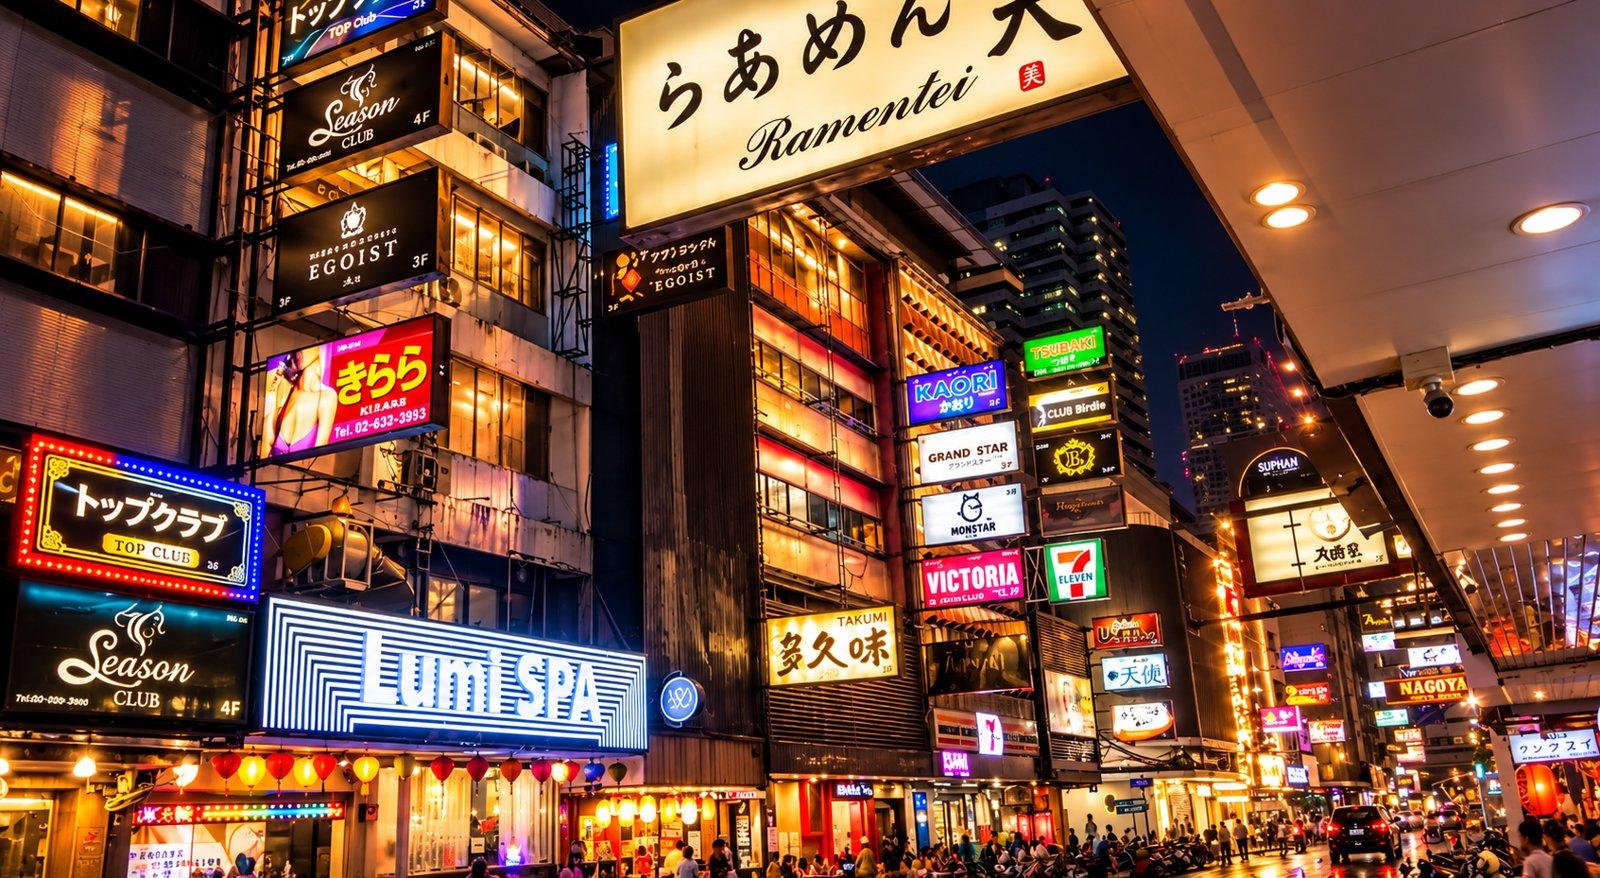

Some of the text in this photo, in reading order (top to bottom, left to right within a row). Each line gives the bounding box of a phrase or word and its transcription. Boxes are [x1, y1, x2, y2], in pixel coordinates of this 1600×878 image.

[328, 11, 377, 39] TOP Club
[1022, 64, 1043, 90] 美
[308, 96, 400, 147] Season
[413, 110, 431, 125] 4F
[739, 65, 978, 171] Ramentei
[341, 128, 374, 149] CLUB
[308, 239, 398, 281] EGOIST
[412, 253, 429, 268] 3F
[655, 267, 716, 292] EGOIST
[279, 296, 291, 308] 3F
[1030, 335, 1097, 360] TSUBAKI
[336, 345, 428, 406] きらら
[915, 370, 998, 403] KAORI
[940, 396, 974, 414] かおり
[1048, 401, 1106, 420] CLUB Birdie
[334, 407, 427, 438] Tel. 02-632-3993
[928, 442, 1008, 463] GRAND STAR
[1257, 457, 1299, 473] SUPHAN
[76, 483, 228, 543] トップクラブ
[951, 521, 996, 537] MONSTAR
[115, 539, 192, 565] TOP CLUB
[926, 562, 1019, 594] VICTORIA
[1058, 572, 1093, 585] ELEVEN
[837, 611, 888, 627] TAKUMI
[57, 629, 195, 688] Season
[777, 627, 890, 677] 多久味
[359, 631, 601, 722] Lumi SPA
[1400, 676, 1469, 695] NAGOYA
[113, 690, 161, 709] CLUB
[220, 700, 241, 716] 4F
